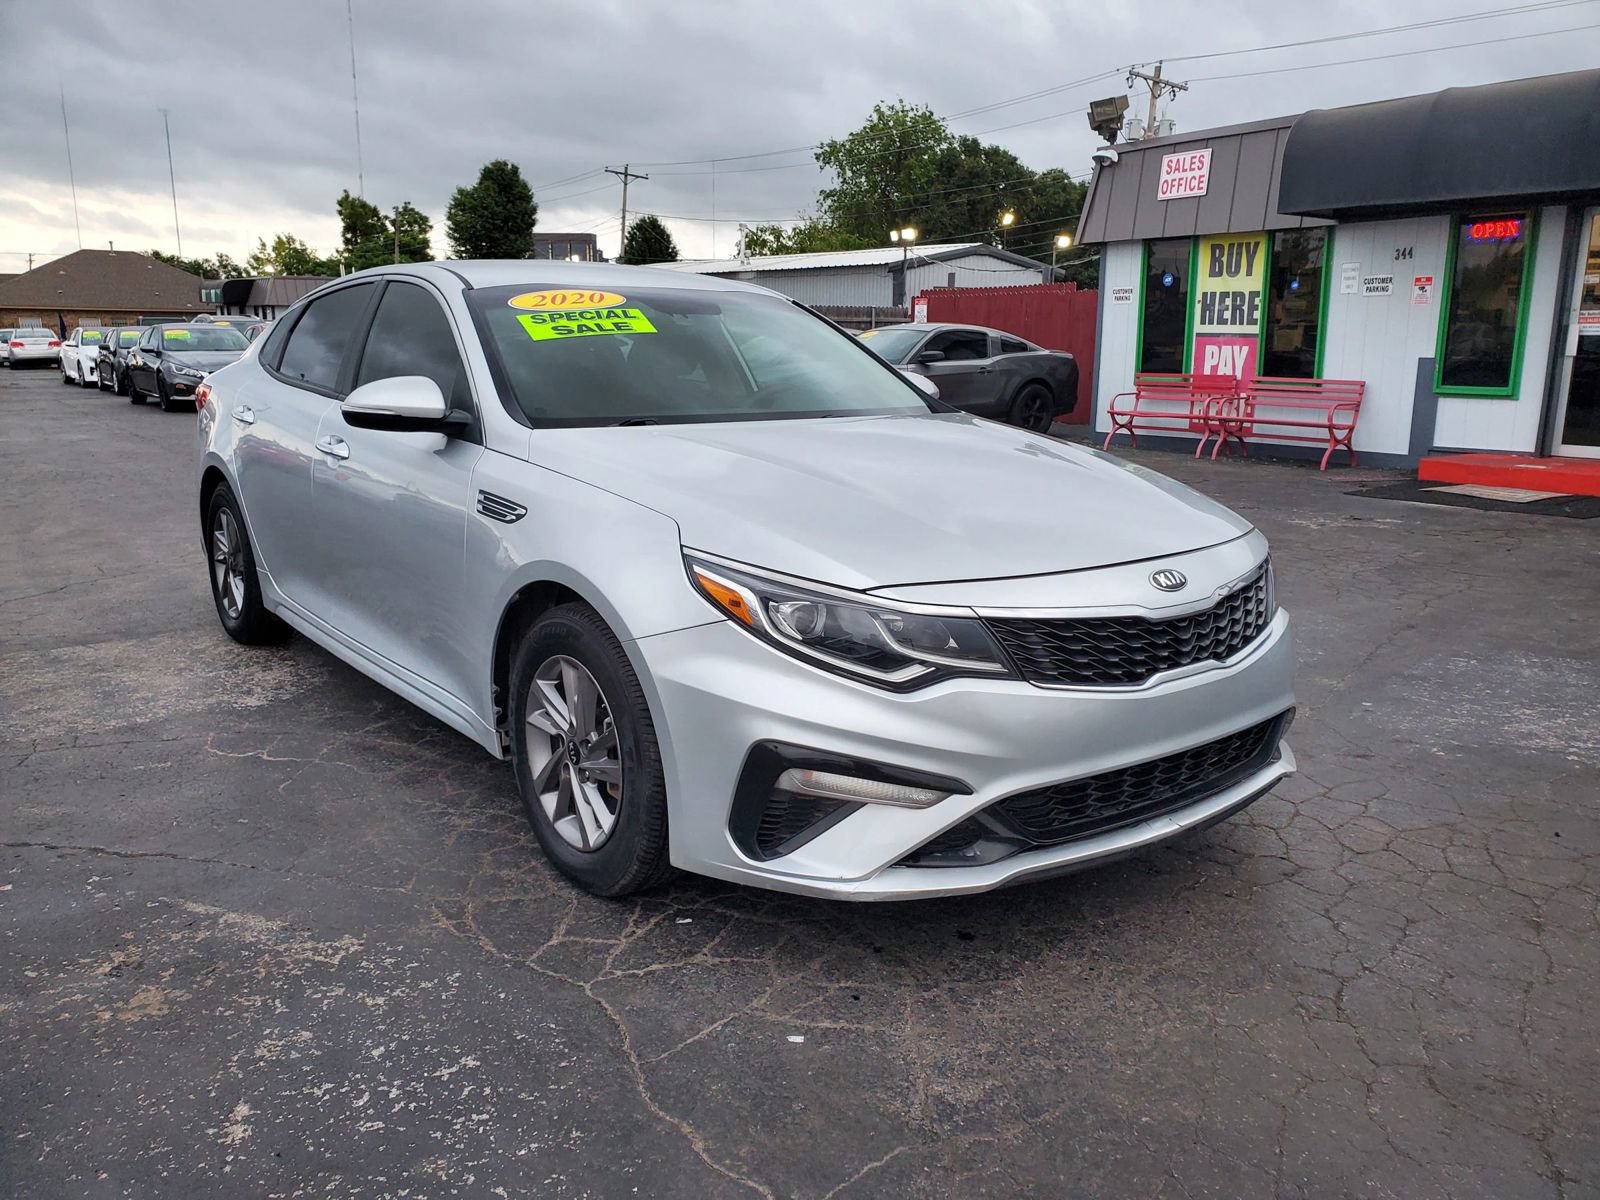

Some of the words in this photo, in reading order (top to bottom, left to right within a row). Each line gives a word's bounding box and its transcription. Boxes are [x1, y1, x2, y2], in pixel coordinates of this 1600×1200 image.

[1166, 154, 1205, 175] SALES
[1161, 174, 1205, 195] OFFICE
[1472, 221, 1518, 238] OPEN
[1209, 241, 1261, 277] BUY
[1395, 246, 1413, 260] 344
[1364, 277, 1393, 285] CUSTOMER
[531, 292, 605, 307] 2020
[1200, 290, 1261, 325] HERE
[531, 310, 637, 325] SPECIAL
[552, 322, 633, 335] SALE
[1203, 345, 1249, 380] PAY
[1154, 570, 1185, 586] KIA
